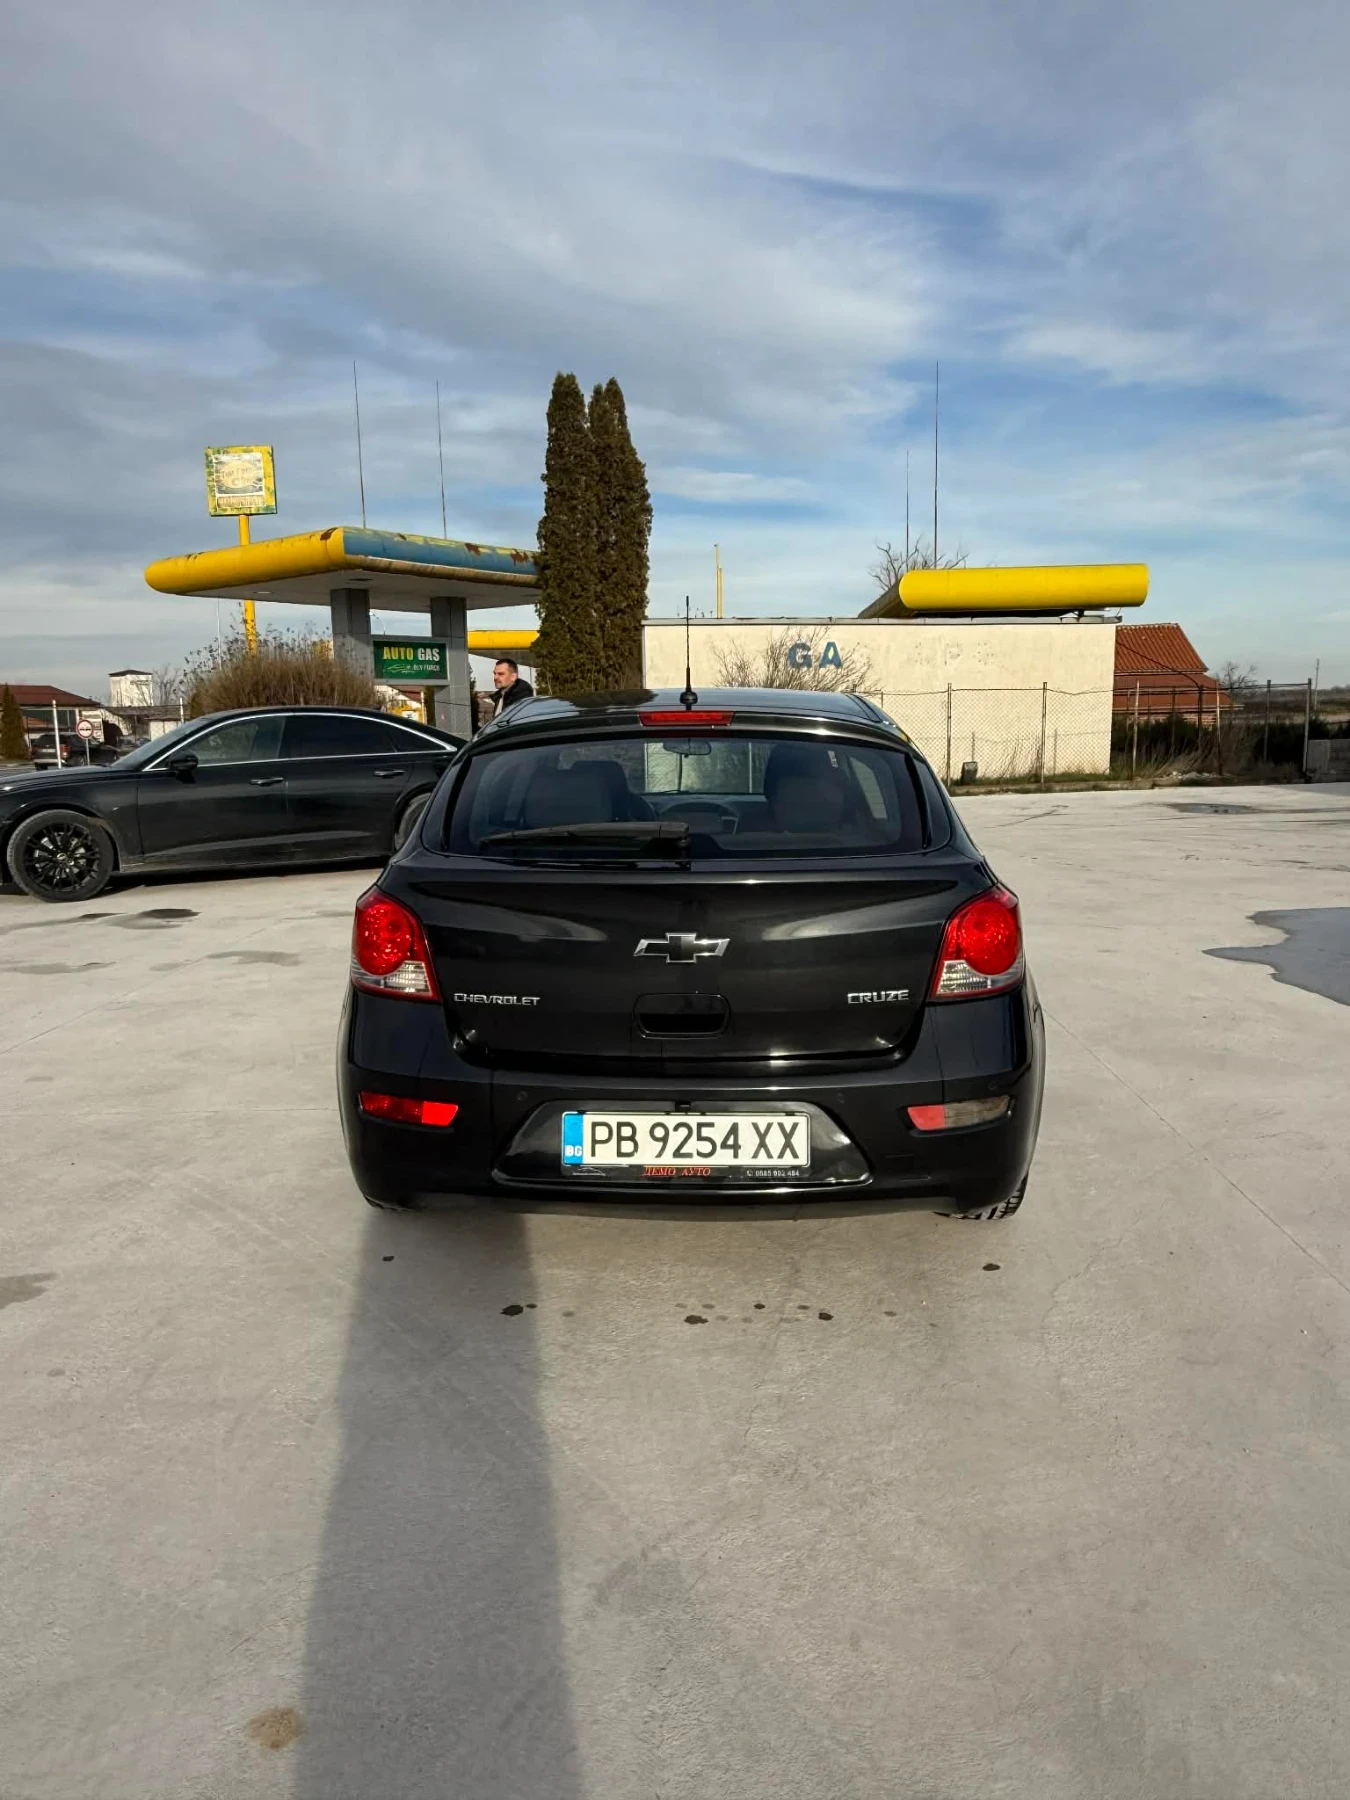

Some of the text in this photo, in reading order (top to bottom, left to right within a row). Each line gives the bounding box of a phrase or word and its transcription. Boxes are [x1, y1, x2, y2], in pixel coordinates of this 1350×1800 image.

[383, 647, 440, 661] AUTO GAS
[787, 641, 843, 669] GA
[454, 992, 541, 1006] CHEVROLET
[847, 989, 909, 1004] CRUZE
[590, 1121, 800, 1159] PB 9254 XX
[565, 1144, 583, 1157] BG
